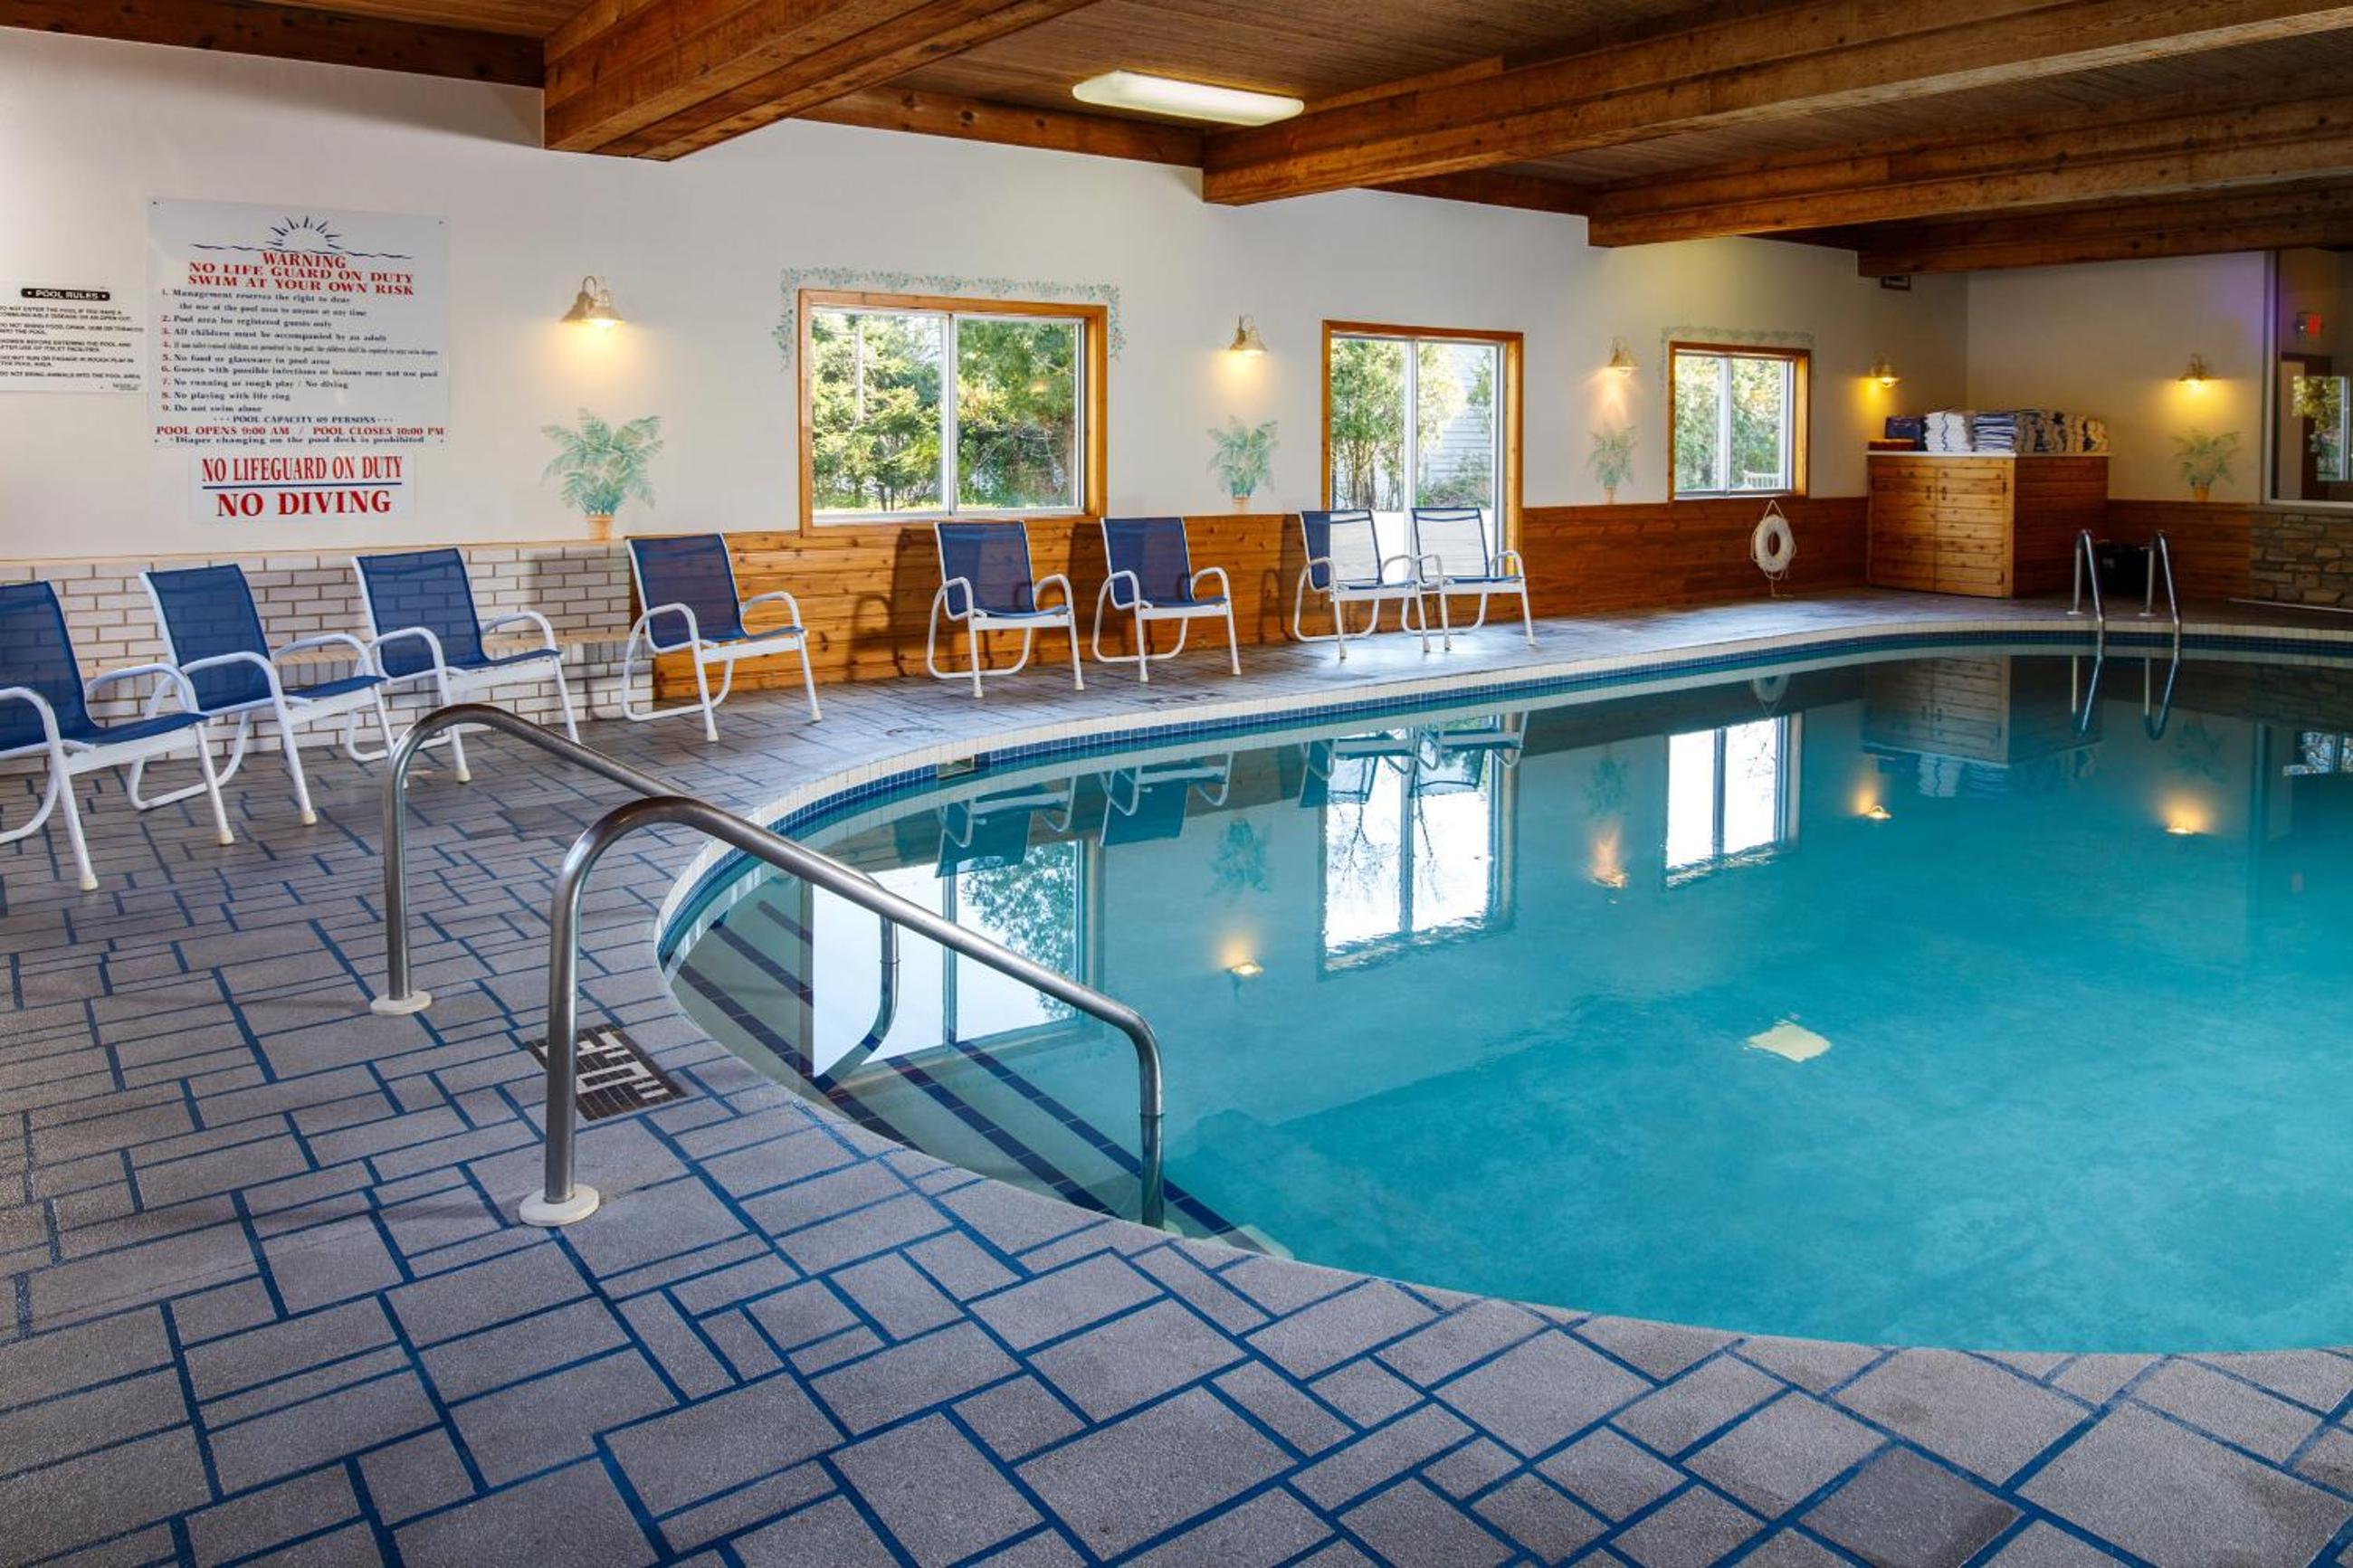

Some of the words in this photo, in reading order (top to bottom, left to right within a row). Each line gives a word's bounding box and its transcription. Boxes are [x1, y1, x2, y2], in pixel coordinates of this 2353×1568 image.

[262, 252, 346, 269] WARNING
[189, 262, 216, 273] NO
[224, 264, 262, 275] LIFE
[272, 266, 331, 280] GUARD
[338, 270, 361, 281] ON
[370, 272, 414, 283] DUTY
[35, 290, 63, 299] POOL
[65, 290, 99, 299] RULES
[188, 275, 237, 287] SWIM
[246, 277, 266, 288] AT
[274, 279, 321, 290] YOUR
[329, 281, 367, 293] OWN
[376, 284, 414, 296] RISK
[233, 415, 258, 423] POOL
[263, 415, 311, 423] CAPACITY
[156, 425, 188, 435] POOL
[195, 425, 236, 435] OPENS
[241, 425, 266, 435] 9:00
[271, 426, 290, 435] AM
[312, 426, 343, 435] POOL
[348, 426, 392, 435] CLOSES
[396, 426, 424, 435] 10:00
[427, 427, 444, 436] PM
[202, 457, 226, 482] NO
[233, 456, 327, 481] LIFEGUARD
[332, 455, 355, 480] ON
[362, 455, 403, 479] DUTY
[216, 491, 263, 518] NO
[277, 489, 391, 516] DIVING
